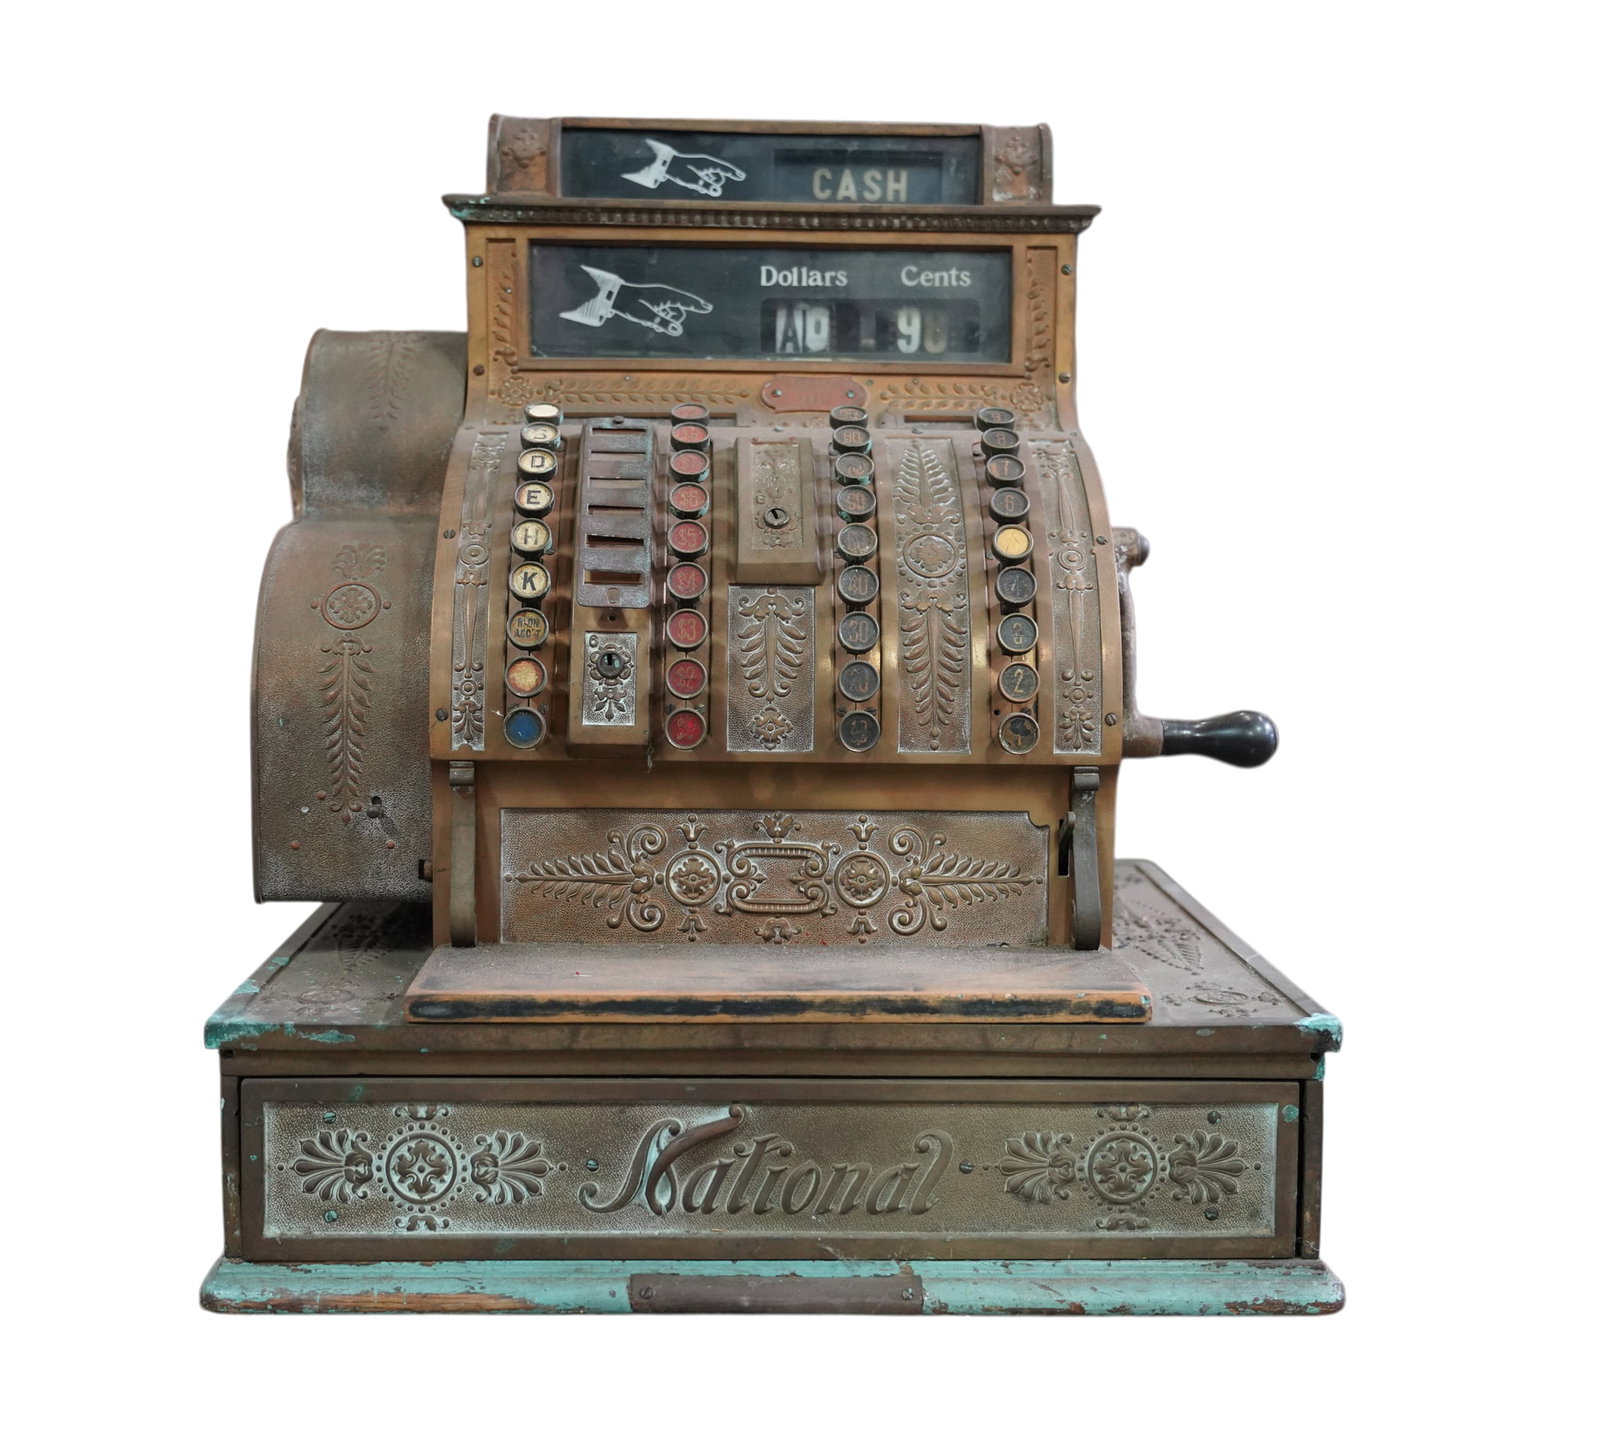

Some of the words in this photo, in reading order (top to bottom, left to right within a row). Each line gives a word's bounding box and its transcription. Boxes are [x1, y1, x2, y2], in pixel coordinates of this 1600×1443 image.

[812, 167, 908, 202] CASH
[760, 265, 849, 287] Dollars
[900, 265, 972, 287] Cents
[530, 455, 546, 468] D
[1001, 459, 1010, 475] 7
[526, 489, 542, 505] E
[1004, 494, 1016, 513] 6
[523, 528, 540, 545] H
[522, 571, 538, 591] K
[678, 618, 697, 641] $3
[848, 620, 869, 643] 30
[589, 634, 599, 648] 6
[1014, 669, 1025, 694] 2
[578, 1101, 954, 1216] National
